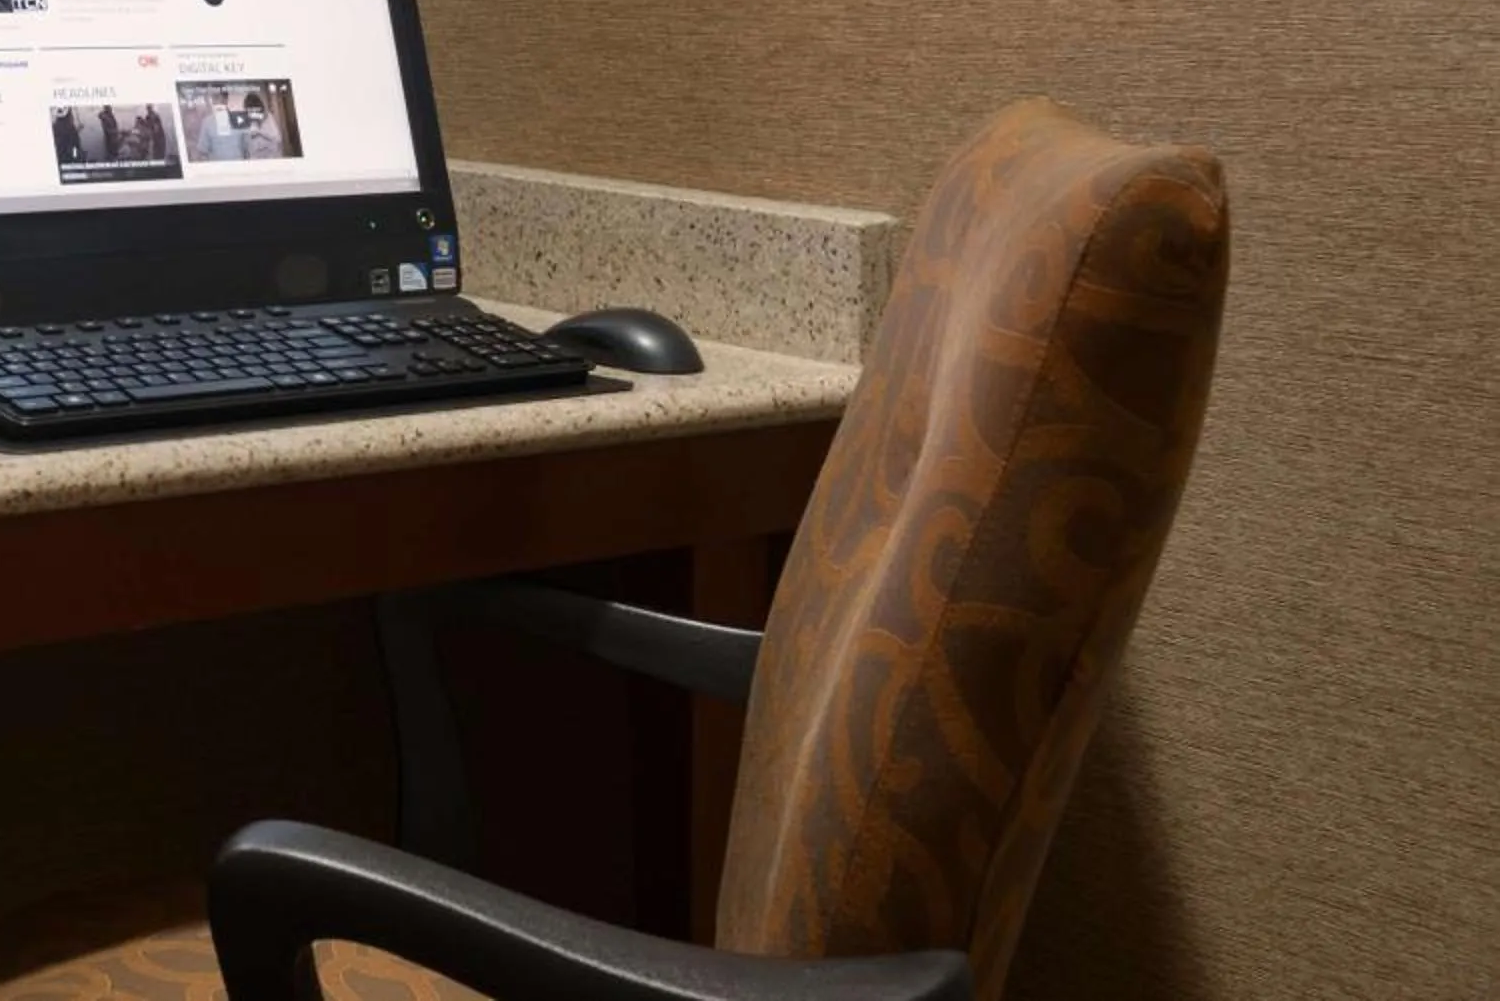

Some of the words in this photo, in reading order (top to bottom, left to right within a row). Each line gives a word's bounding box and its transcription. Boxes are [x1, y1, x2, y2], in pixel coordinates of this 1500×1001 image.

[178, 62, 220, 74] DIGITAL
[224, 62, 245, 73] KEY
[52, 86, 117, 99] HEADLINES
